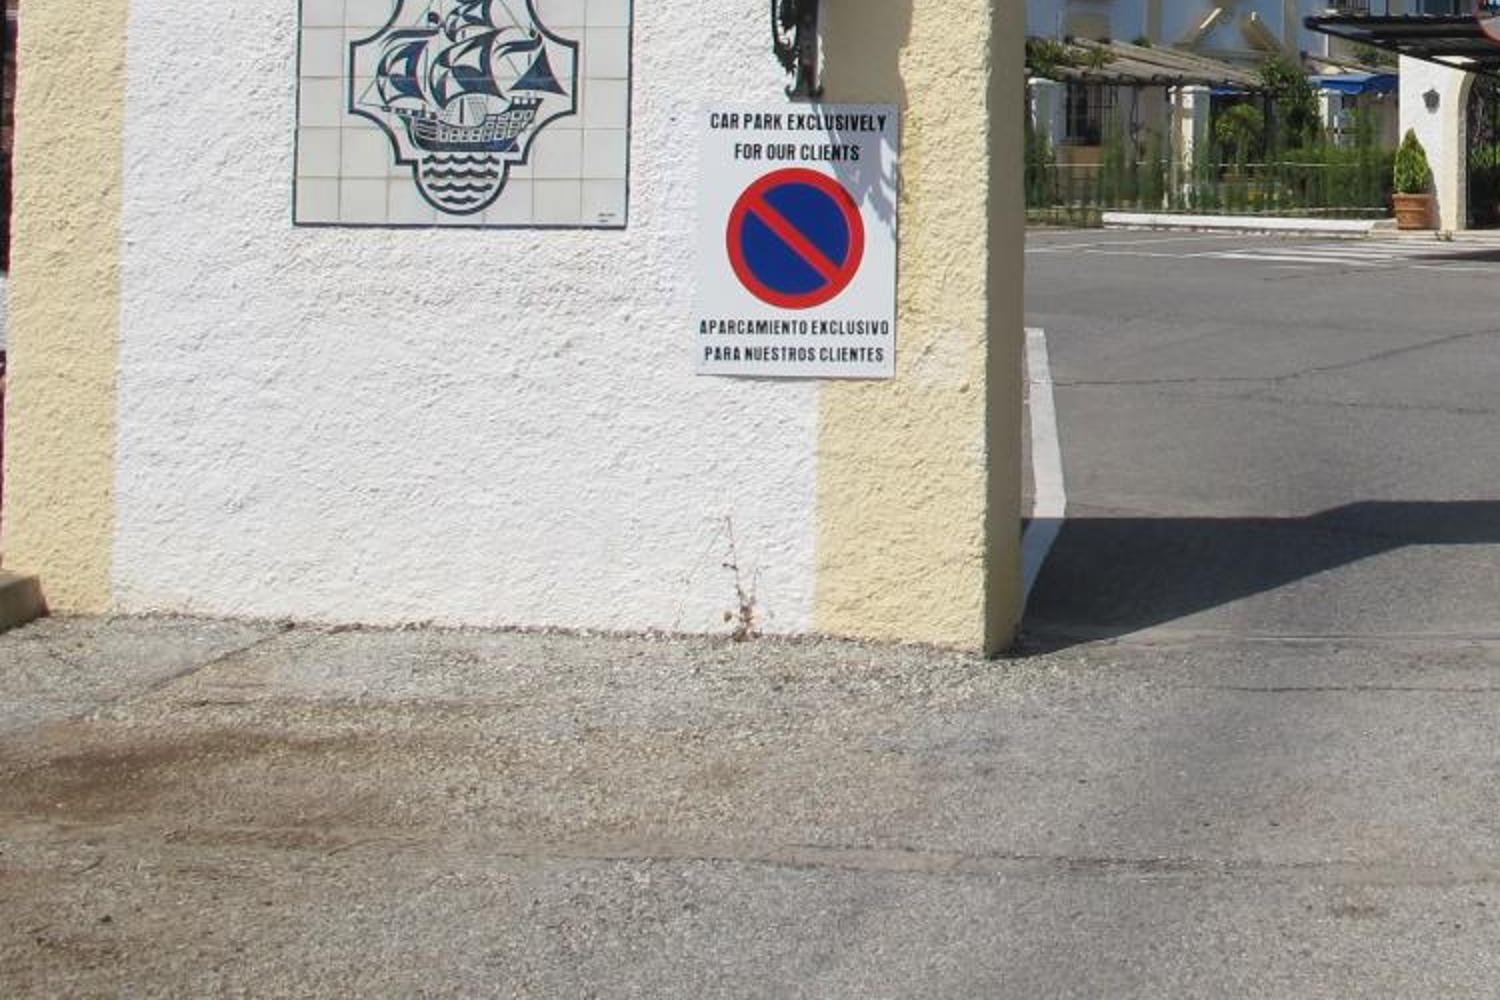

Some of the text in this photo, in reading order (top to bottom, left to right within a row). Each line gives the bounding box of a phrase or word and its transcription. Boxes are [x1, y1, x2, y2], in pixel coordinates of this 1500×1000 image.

[711, 113, 887, 132] CAR PARK EXCLUSIVELY
[735, 144, 860, 161] FOR OUR CLIENTS
[699, 320, 889, 335] APARCAMIENTO EXCLUSIVO
[705, 347, 884, 362] PARA NUESTROS CLIENTES
